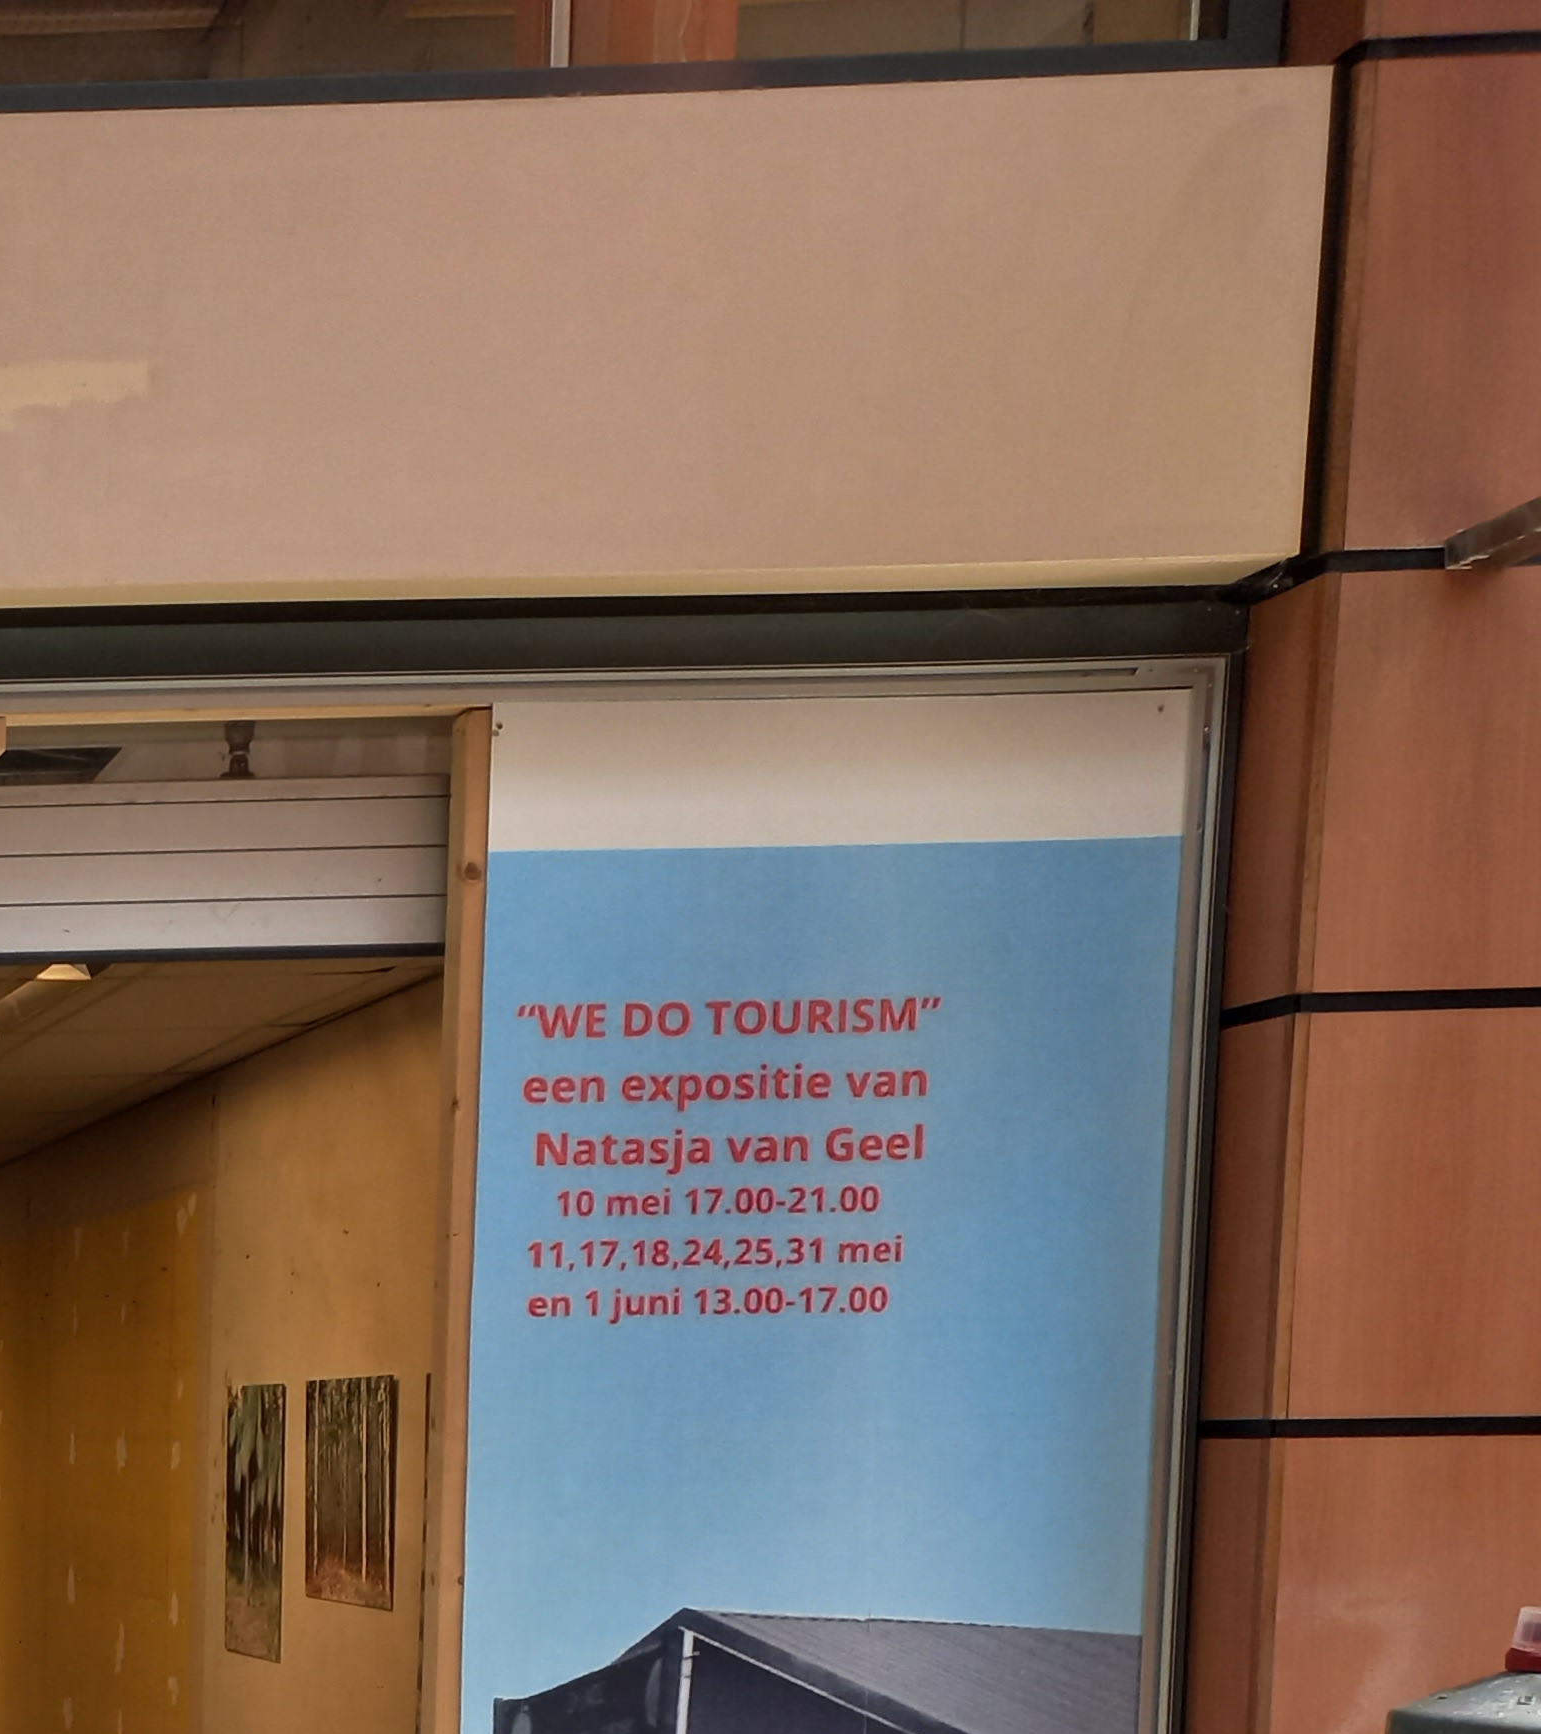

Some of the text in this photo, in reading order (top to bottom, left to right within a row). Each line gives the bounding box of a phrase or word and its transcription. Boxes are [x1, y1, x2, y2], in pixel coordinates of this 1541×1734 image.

[623, 1002, 692, 1038] DO
[522, 1064, 928, 1111] een expositie van
[535, 1124, 924, 1176] Natasja van Geel
[559, 1185, 881, 1217] 10 mei 17.00-21.00
[527, 1235, 902, 1271] 11,17,18,24,25,31 mei
[527, 1284, 889, 1324] en 1 juni 13.00-17.00
